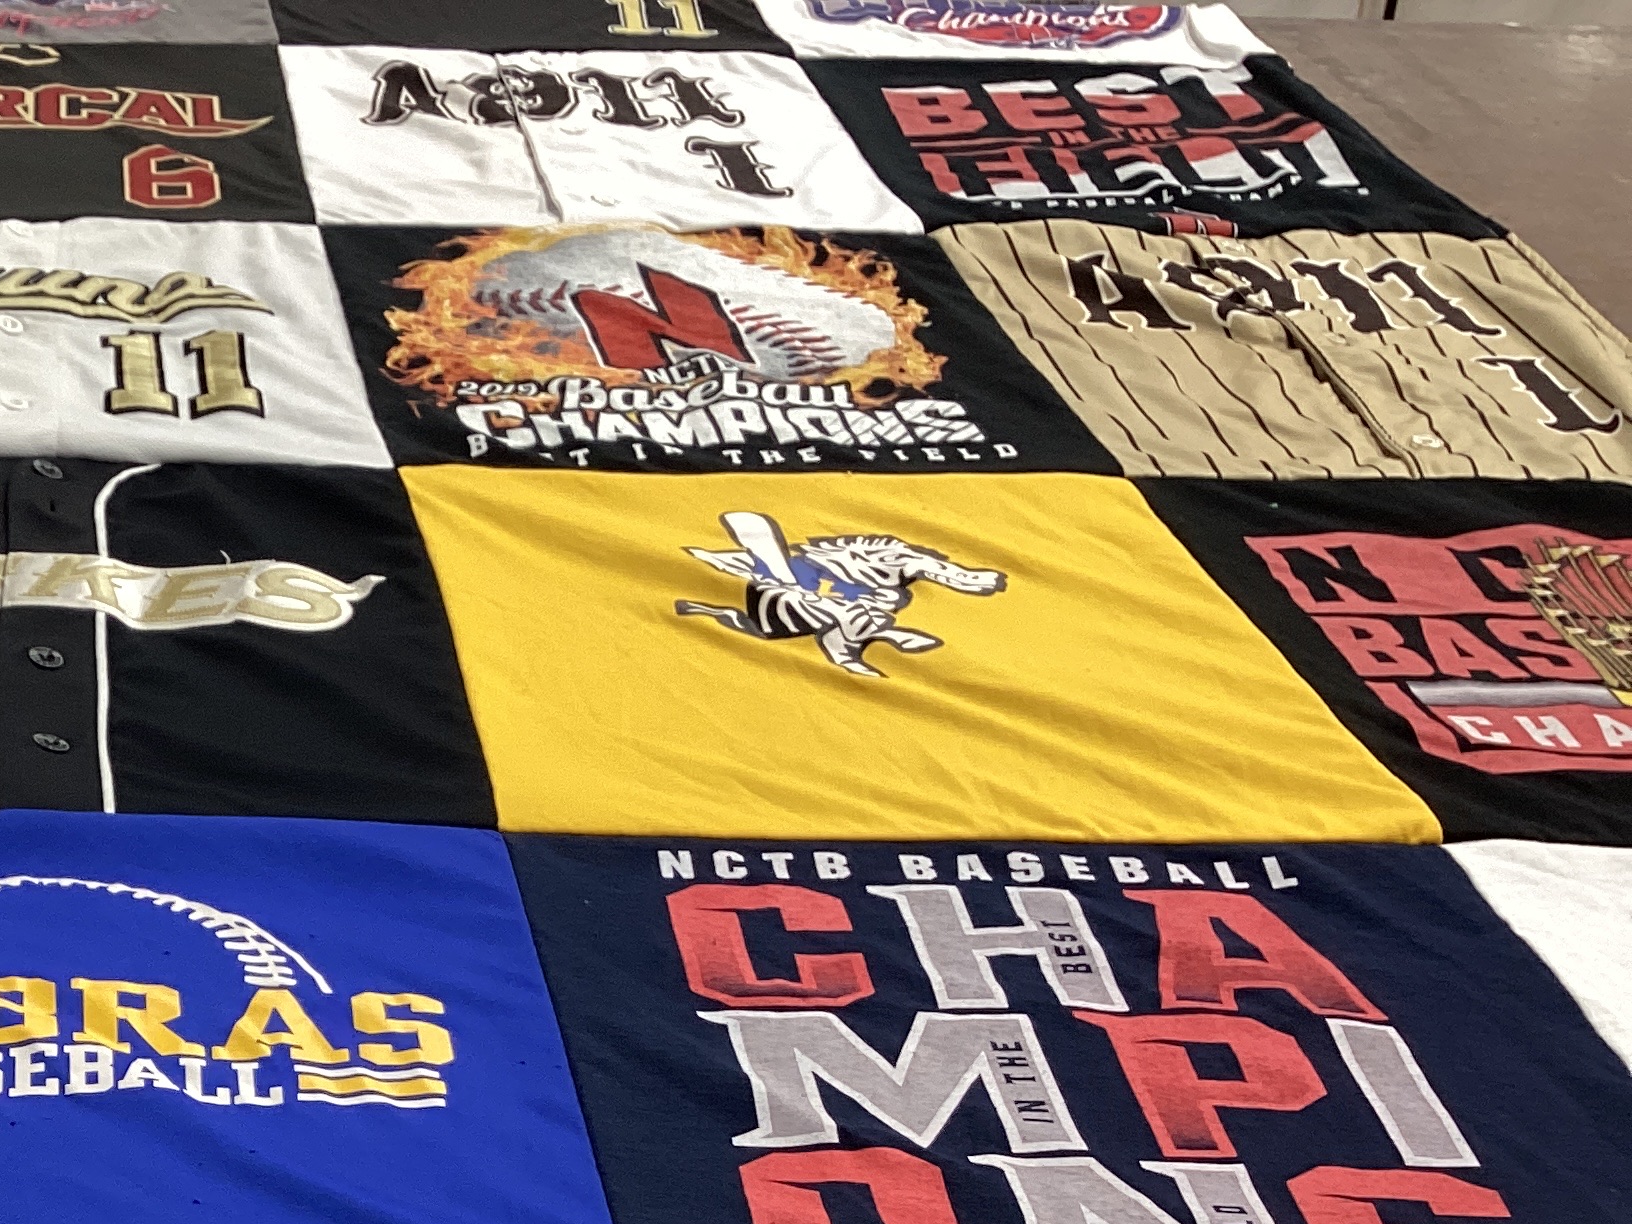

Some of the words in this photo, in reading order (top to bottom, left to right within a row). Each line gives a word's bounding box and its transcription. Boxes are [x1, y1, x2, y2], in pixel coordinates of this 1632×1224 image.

[879, 66, 1264, 138] BEST
[1052, 131, 1092, 147] IN
[1114, 126, 1182, 144] THE
[121, 144, 221, 208] 6
[685, 135, 794, 198] 1
[99, 329, 265, 419] 11
[456, 380, 539, 397] 2019
[1472, 355, 1624, 434] 1
[454, 399, 987, 449] CHAMPIONS
[467, 433, 591, 468] BT
[722, 448, 823, 467] THE
[657, 849, 852, 882] NCTB
[897, 850, 1299, 891] BASEBALL
[1040, 920, 1093, 974] BEST
[989, 1041, 1037, 1084] THE
[1014, 1100, 1055, 1123] IN
